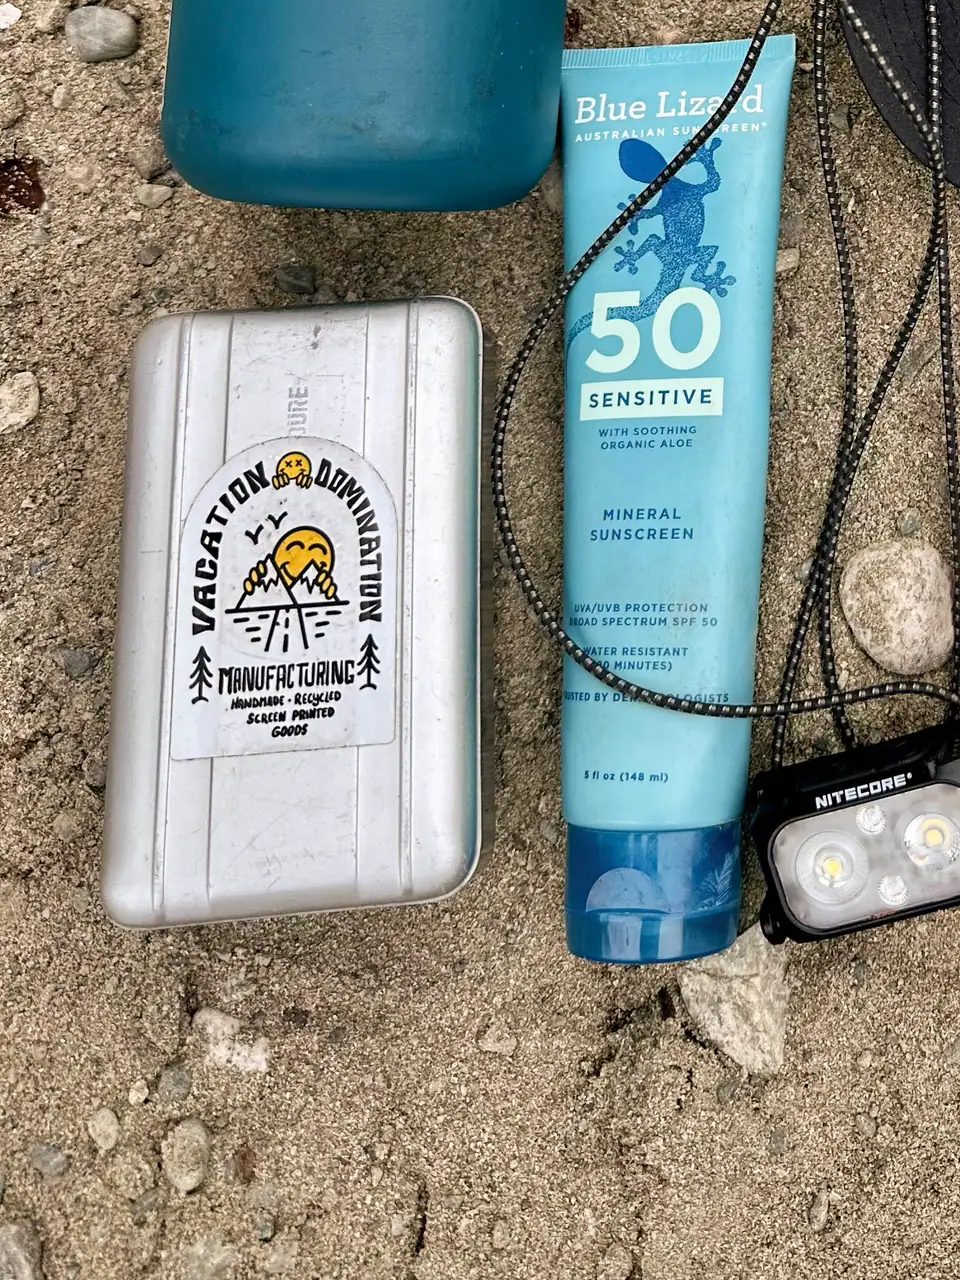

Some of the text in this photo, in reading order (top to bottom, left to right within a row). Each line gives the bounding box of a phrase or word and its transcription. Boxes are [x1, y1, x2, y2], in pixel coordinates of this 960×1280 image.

[575, 84, 764, 124] Blue Lizad
[575, 122, 760, 143] AUSTRALIAN SUNREEN
[586, 286, 721, 373] 50
[589, 388, 713, 408] SENSITIVE
[598, 425, 697, 439] WITH SOOTHING
[600, 438, 693, 450] ORGANIC ALOE
[603, 507, 682, 521] MINERAL
[590, 528, 695, 541] SUNSCREEN
[192, 457, 383, 635] VACATION DOMINATION
[574, 602, 708, 612] UVA/UVB PROTECTION
[602, 617, 667, 627] SPECTRUM
[673, 617, 698, 627] SPF
[702, 617, 718, 627] 50
[583, 647, 689, 656] WATER RESISTANT
[218, 659, 356, 695] MANUFACTURING
[231, 690, 341, 710] HANDMADE RECYCLED
[594, 692, 608, 702] BY
[246, 707, 335, 725] SCREEN PRINTED
[272, 723, 308, 738] GOODS
[584, 770, 669, 783] 5 fl oz (148 ml)
